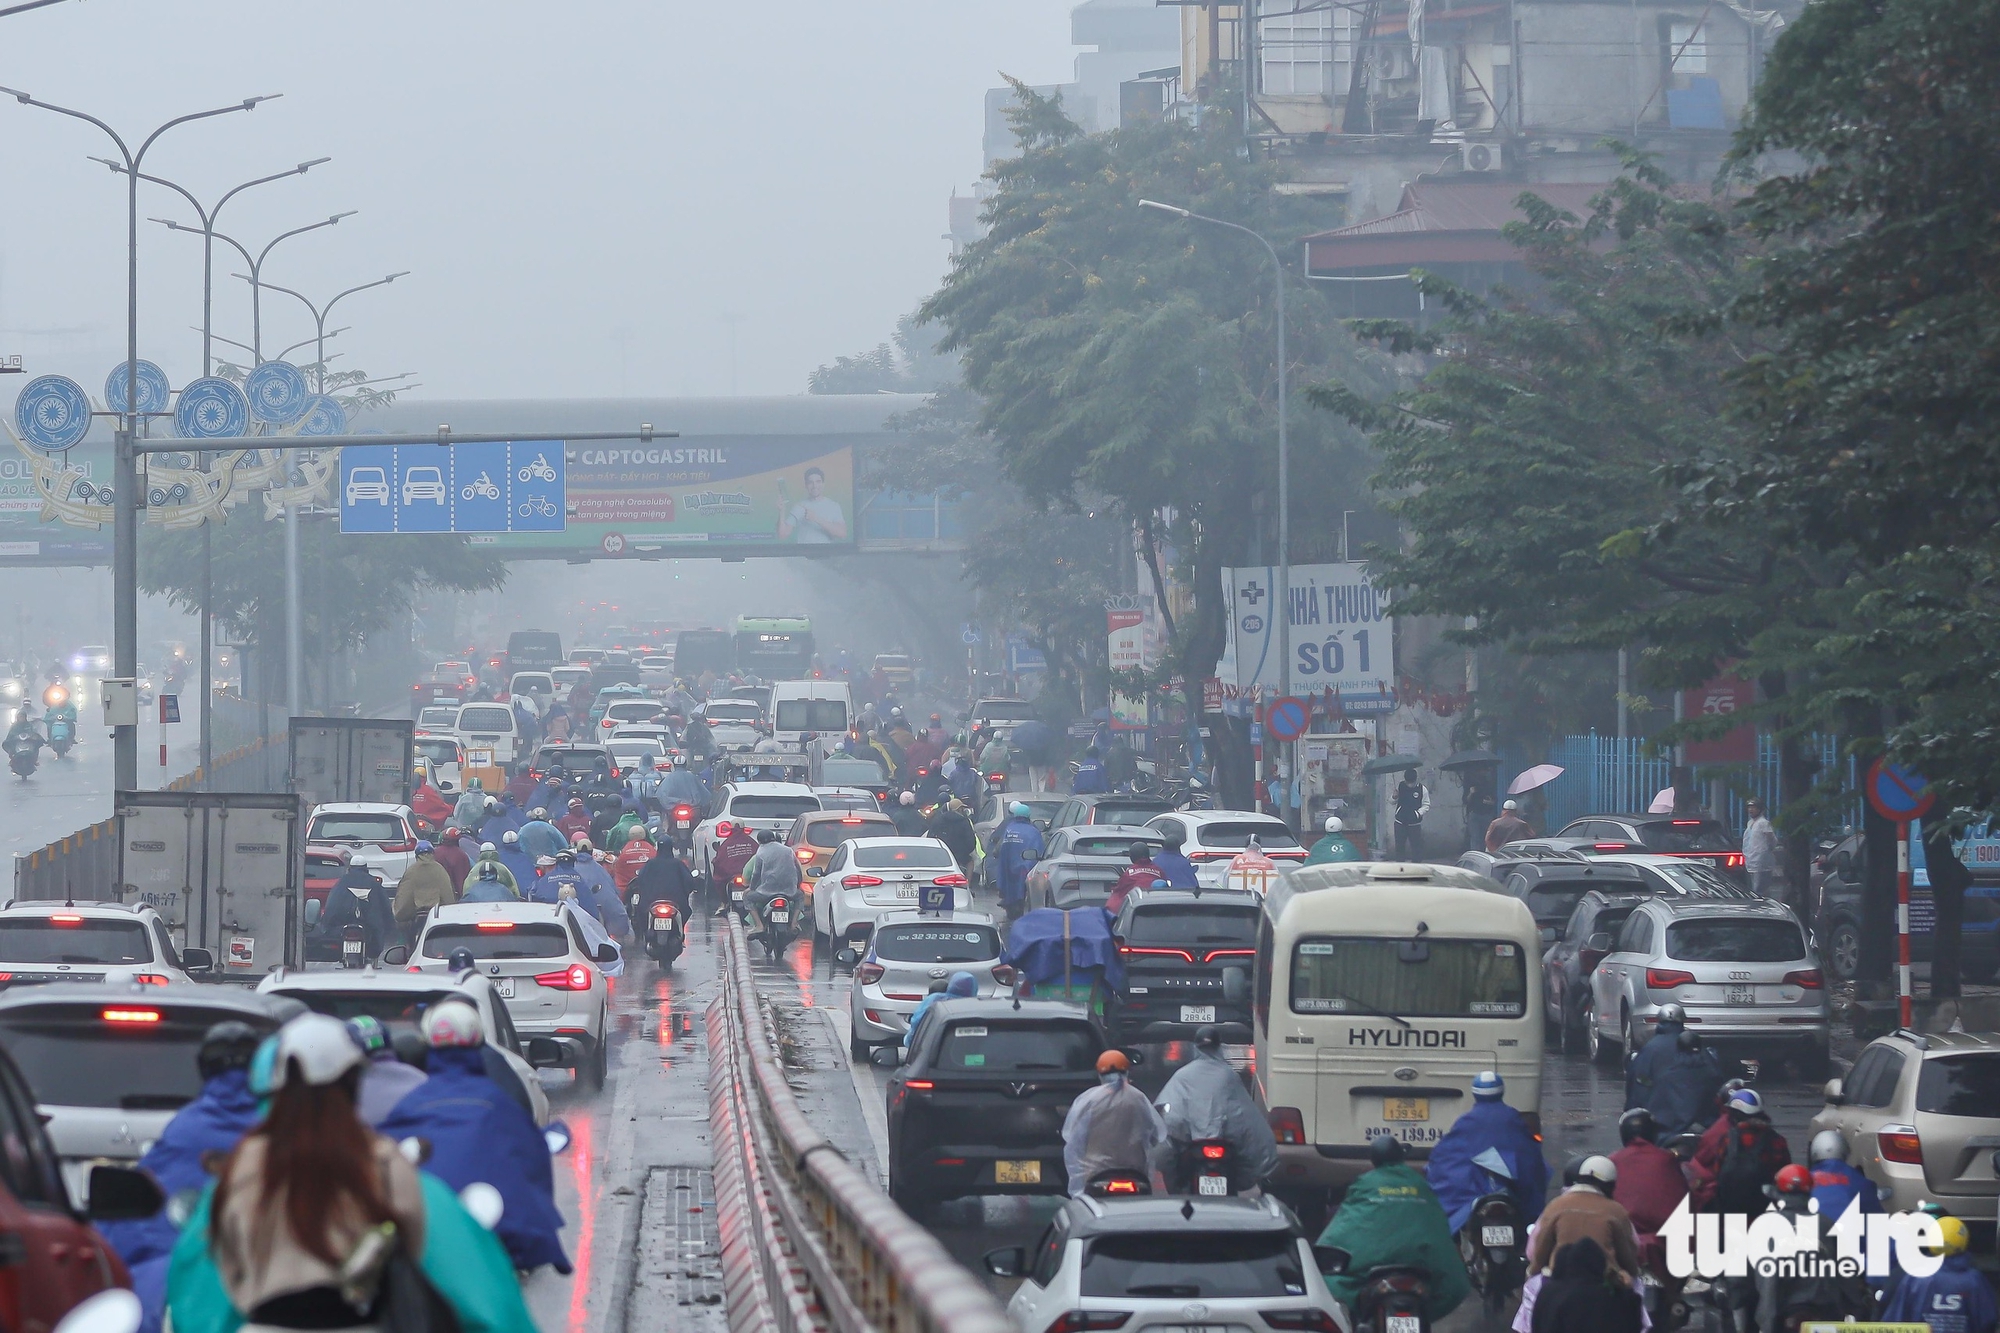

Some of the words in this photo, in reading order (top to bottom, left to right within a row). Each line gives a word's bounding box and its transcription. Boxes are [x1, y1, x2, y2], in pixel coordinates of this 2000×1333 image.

[582, 449, 727, 465] CAPTOGASTRIL
[582, 498, 602, 508] công
[627, 498, 672, 507] Orosoluble
[593, 512, 614, 520] ngay
[616, 511, 638, 520] trong
[640, 510, 666, 520] miệng
[1290, 579, 1319, 625] NHÀ
[1244, 620, 1260, 633] 205
[1297, 630, 1344, 674] SỐ
[1352, 630, 1369, 672] 1
[1349, 1028, 1465, 1048] HYUNDAI
